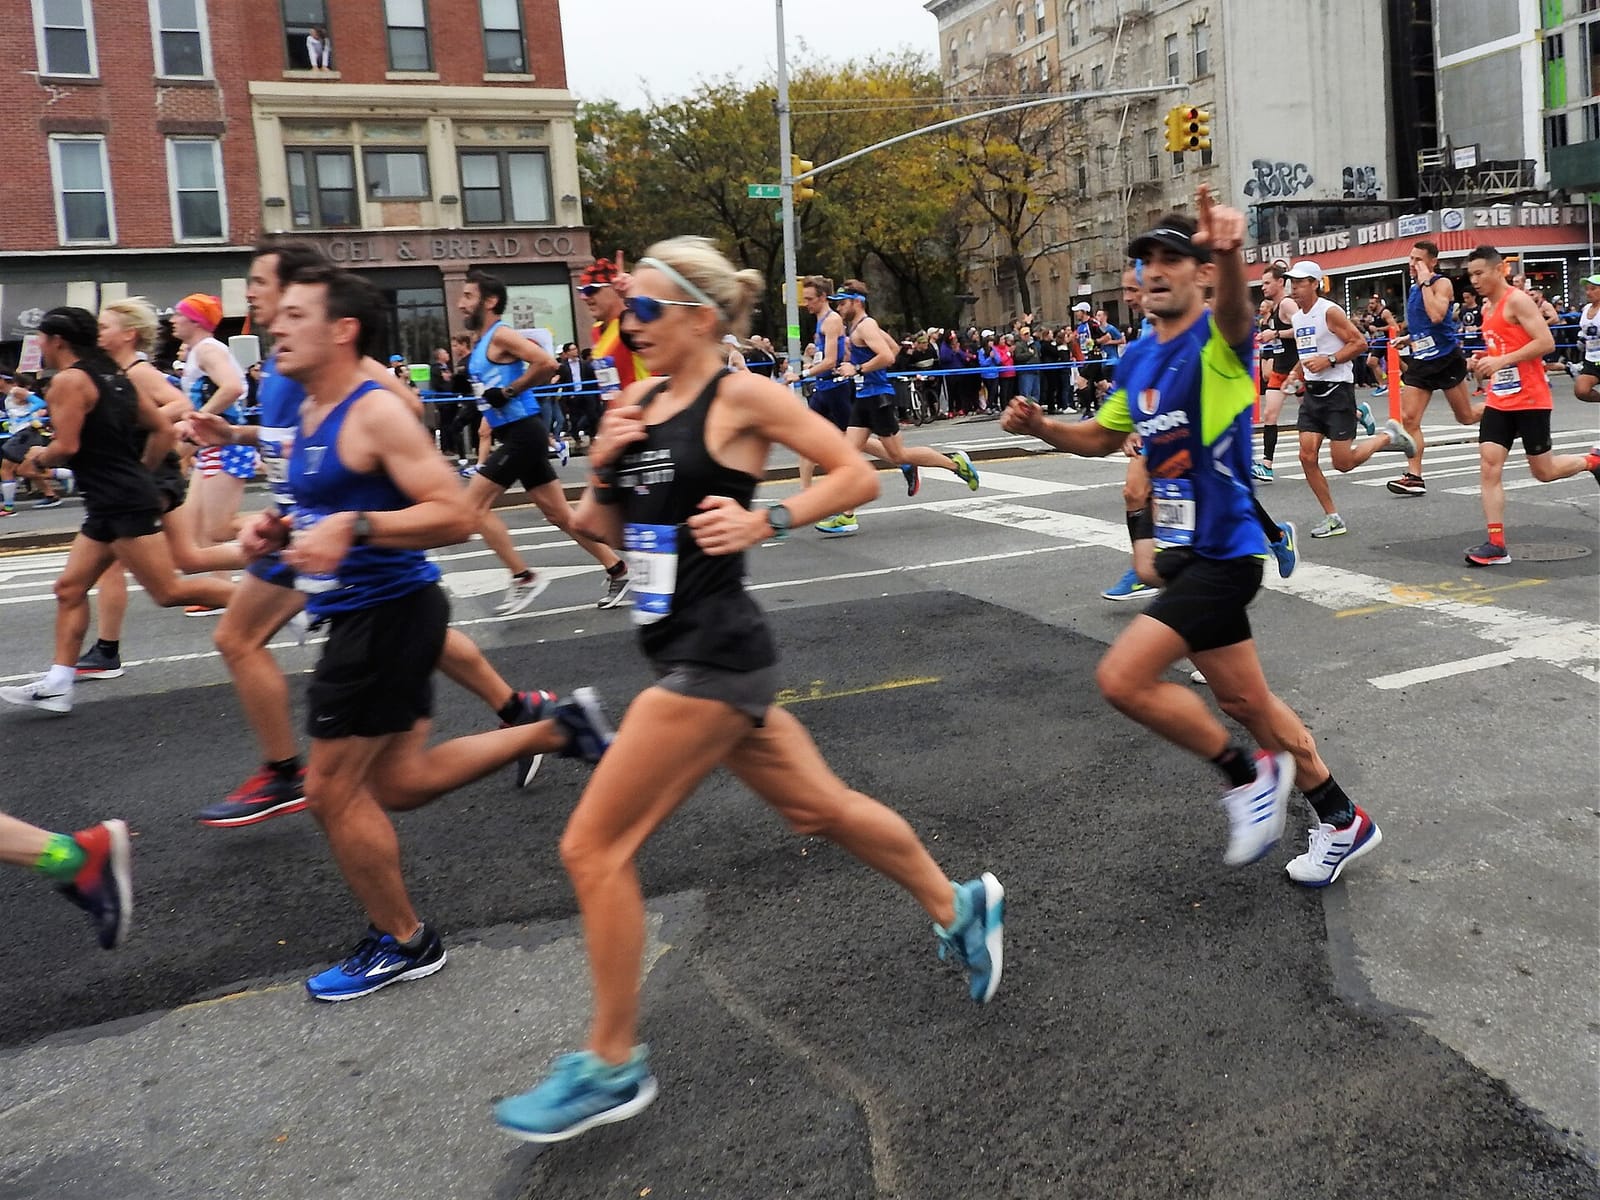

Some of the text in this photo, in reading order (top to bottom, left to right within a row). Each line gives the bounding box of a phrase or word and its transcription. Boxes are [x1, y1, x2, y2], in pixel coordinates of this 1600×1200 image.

[755, 187, 762, 196] 4
[1473, 208, 1511, 227] 215
[1518, 207, 1560, 226] FINE
[398, 239, 417, 260] &
[431, 237, 521, 259] BREAD
[533, 236, 576, 257] CO.
[1261, 241, 1292, 263] FINE
[1298, 231, 1351, 256] FOODS
[1357, 222, 1396, 246] DELI
